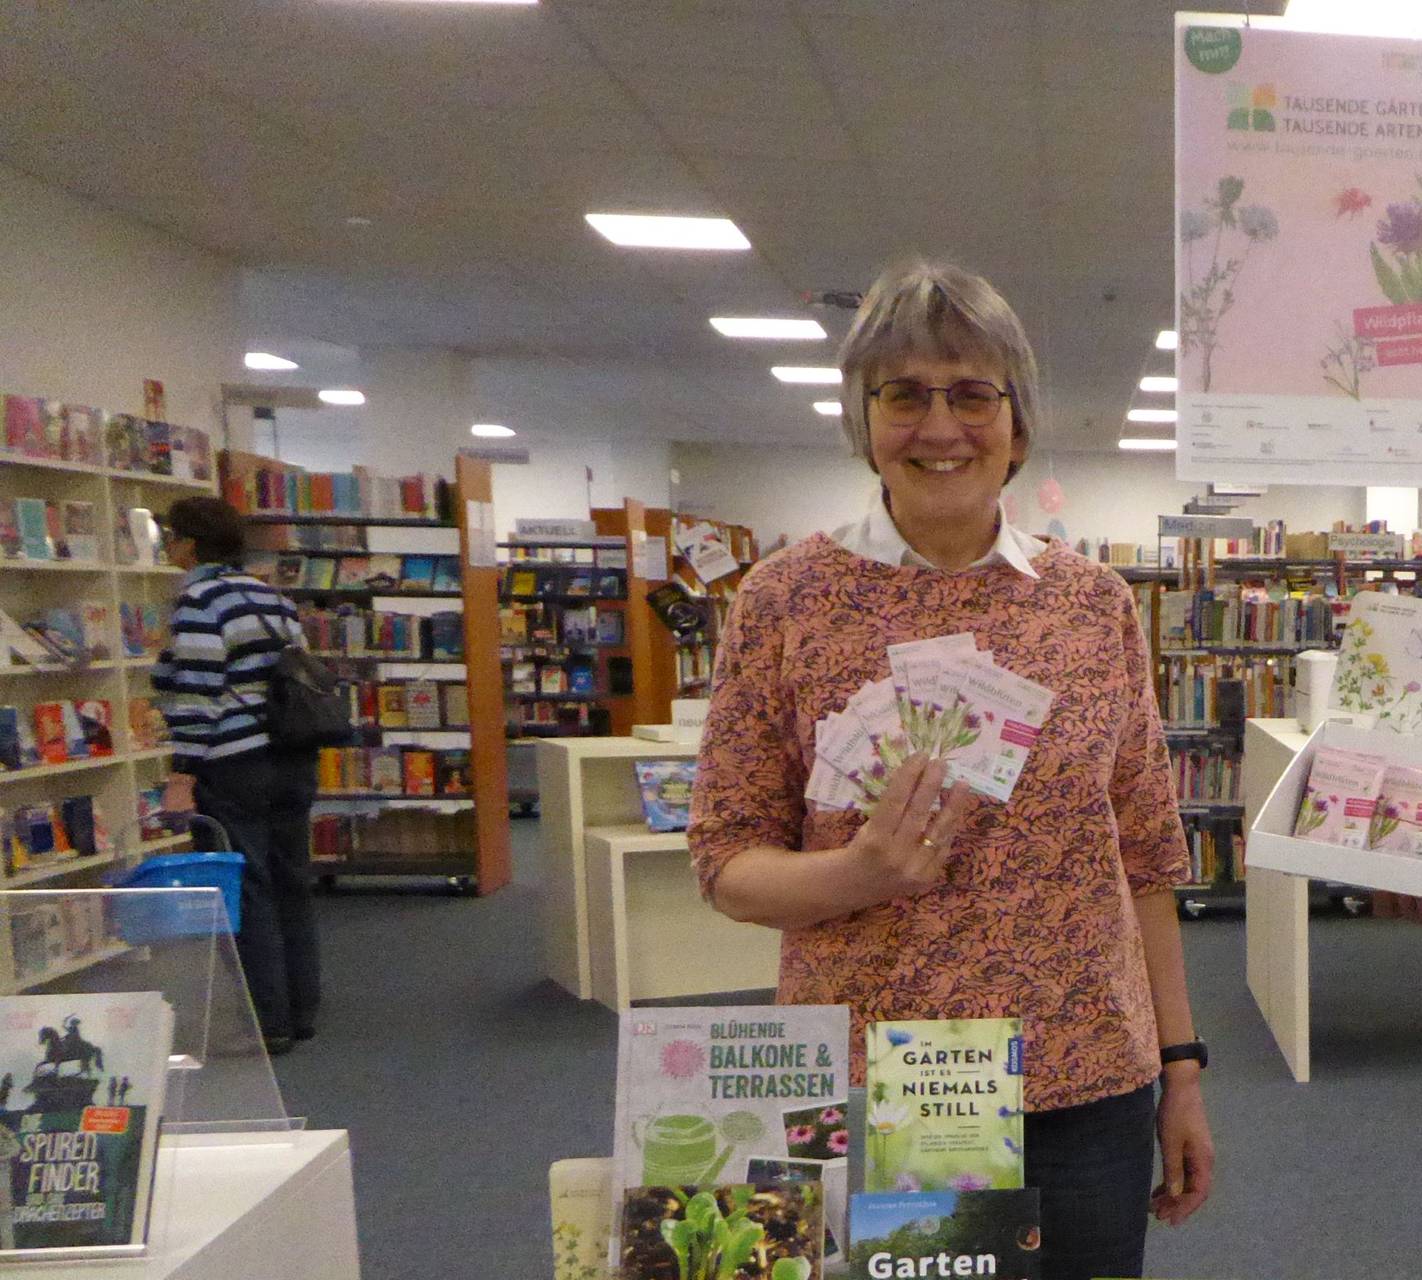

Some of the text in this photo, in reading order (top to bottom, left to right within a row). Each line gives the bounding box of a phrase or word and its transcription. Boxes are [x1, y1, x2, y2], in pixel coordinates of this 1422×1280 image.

[1284, 96, 1370, 117] TAUSENDE
[1282, 117, 1370, 136] TAUSENDE
[710, 1020, 786, 1040] BLÜHENDE
[709, 1043, 833, 1069] BALKONE &
[903, 1049, 992, 1066] GARTEN
[708, 1073, 835, 1099] TERRASSEN
[902, 1080, 998, 1097] NIEMALS
[920, 1101, 980, 1118] STILL
[28, 1161, 101, 1194] FINDER
[867, 1251, 996, 1280] Garten
